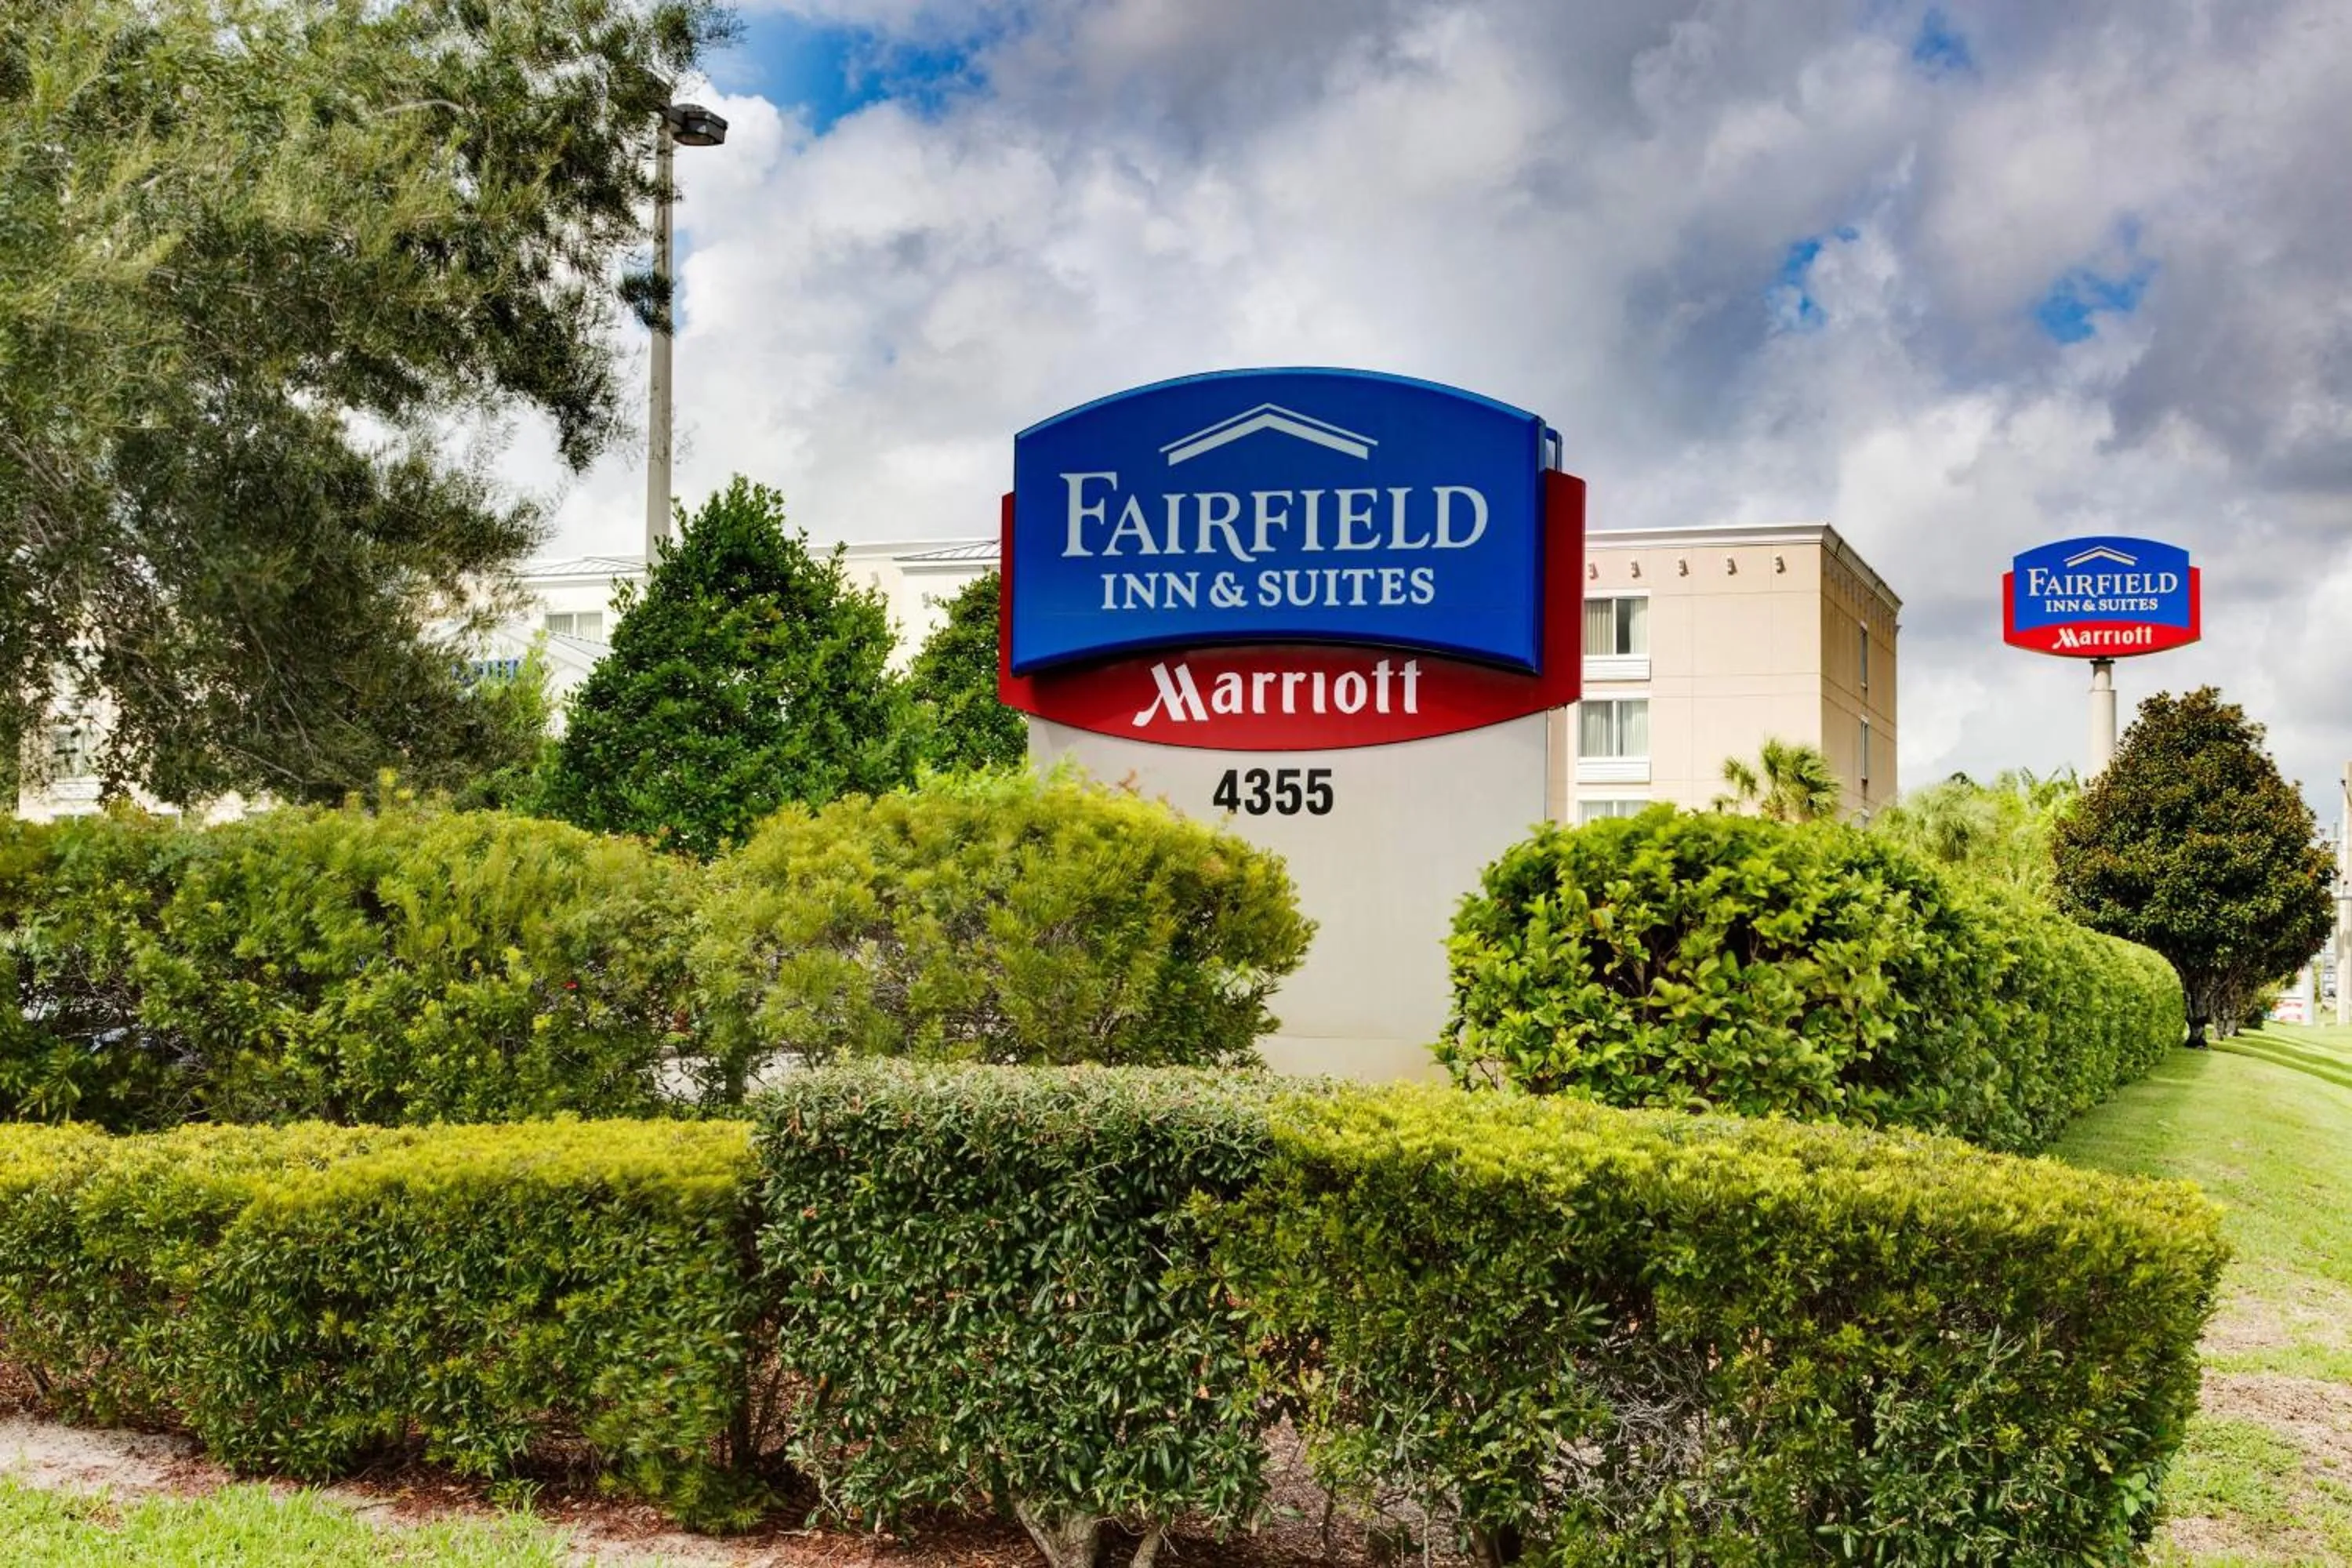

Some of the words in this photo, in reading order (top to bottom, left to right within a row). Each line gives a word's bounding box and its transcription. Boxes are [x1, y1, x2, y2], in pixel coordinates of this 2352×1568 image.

[1059, 470, 1489, 562] FAIRFIELD
[1101, 572, 1199, 609] INN
[1209, 571, 1248, 608] &
[1258, 567, 1436, 608] SUITES
[2027, 568, 2178, 597] FAIRFIELD
[2045, 599, 2080, 612] INN
[2082, 599, 2096, 612] &
[2101, 598, 2158, 612] SUITES
[2052, 626, 2152, 649] Marriott
[1131, 659, 1422, 728] Marriott
[1213, 768, 1334, 816] 4355
